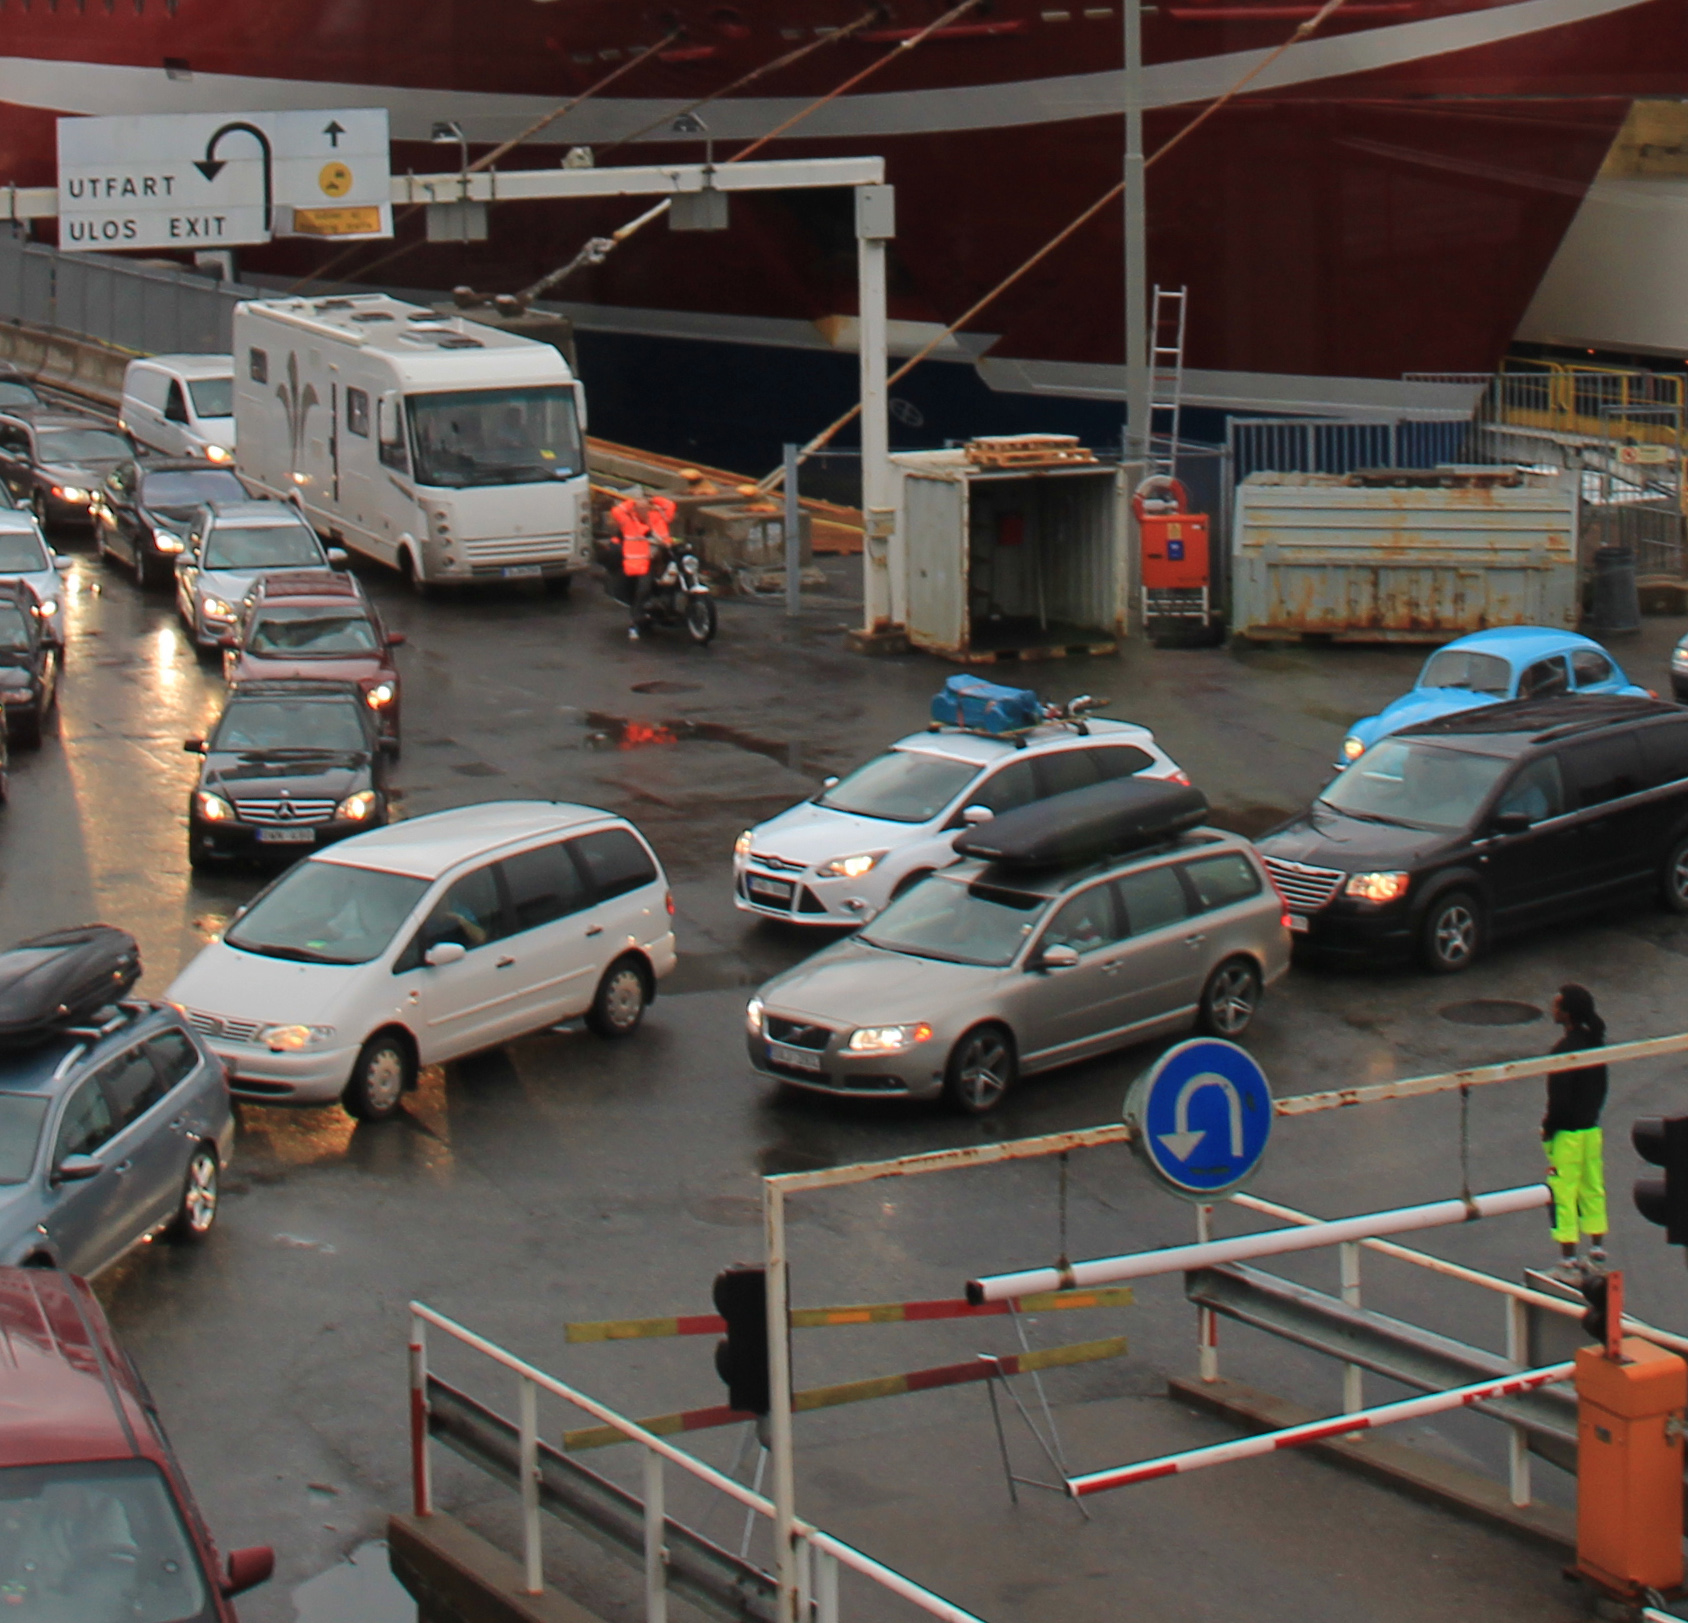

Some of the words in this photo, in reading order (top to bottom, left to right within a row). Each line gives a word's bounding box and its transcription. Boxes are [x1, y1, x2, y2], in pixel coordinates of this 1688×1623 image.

[68, 175, 176, 199] UTFART
[69, 218, 138, 242] ULOS
[169, 216, 227, 238] EXIT
